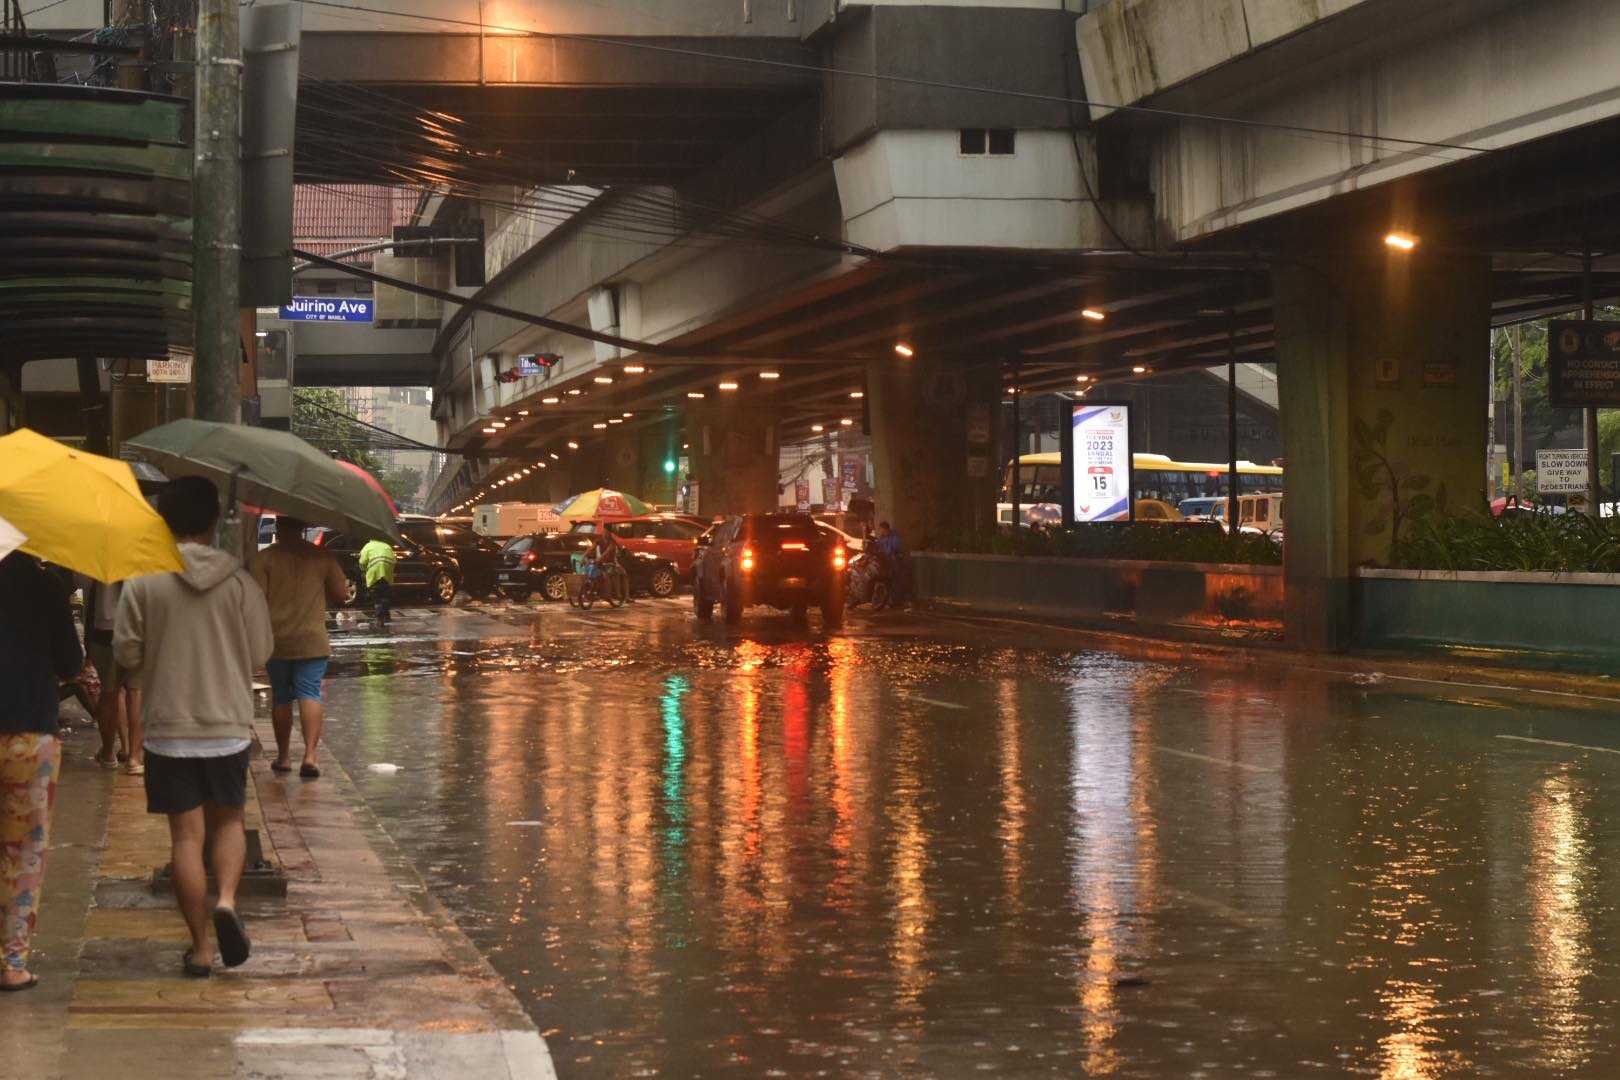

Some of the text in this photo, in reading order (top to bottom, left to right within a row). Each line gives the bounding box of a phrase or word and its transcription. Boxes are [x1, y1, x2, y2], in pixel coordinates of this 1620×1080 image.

[339, 300, 367, 313] Ave
[305, 313, 318, 321] CITY
[1086, 441, 1113, 451] 2023
[1541, 460, 1588, 468] SLOW DOWN
[1093, 476, 1107, 490] 15
